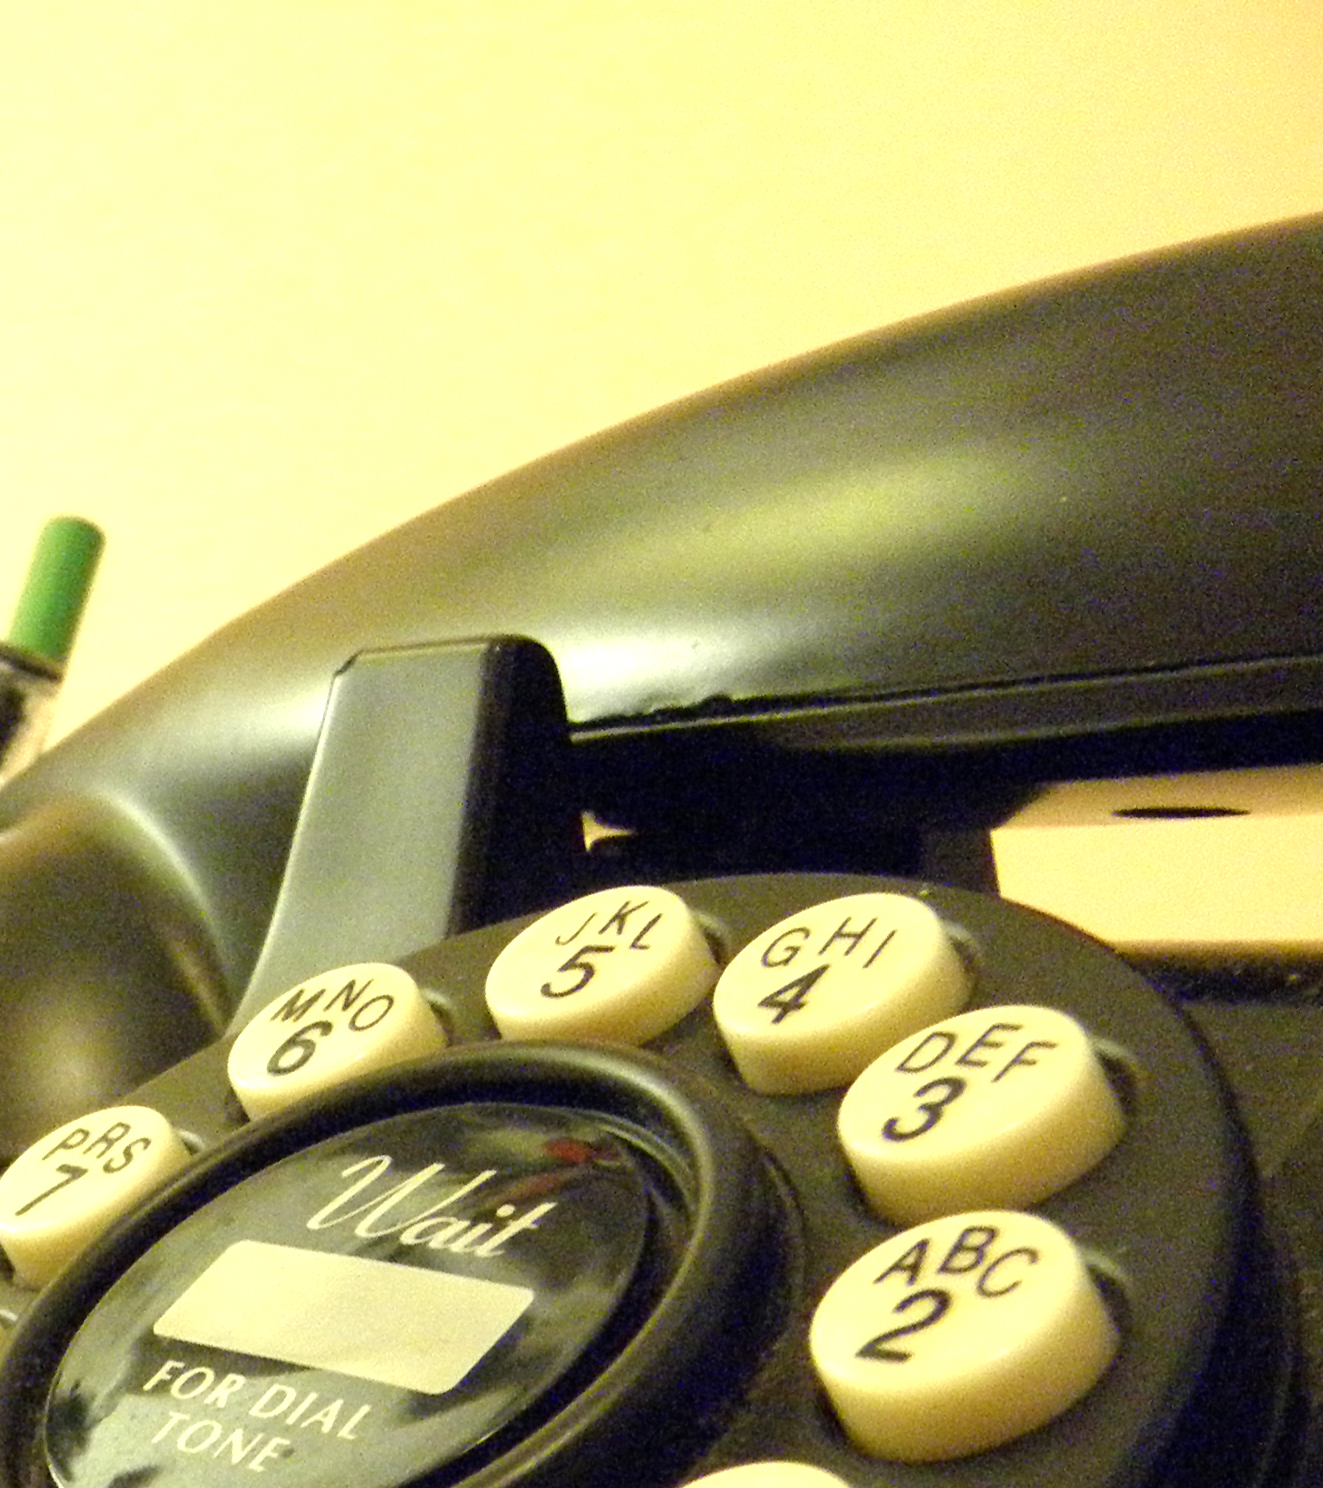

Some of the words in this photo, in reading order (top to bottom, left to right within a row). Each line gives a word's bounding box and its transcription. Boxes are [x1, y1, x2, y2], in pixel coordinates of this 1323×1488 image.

[554, 898, 664, 952] JKL
[759, 915, 898, 970] GHI
[539, 944, 616, 999] 5
[756, 963, 832, 1026] 4
[269, 978, 395, 1033] MNO
[266, 1019, 334, 1077] 6
[894, 1021, 1059, 1084] DEF
[880, 1077, 969, 1144] 3
[42, 1120, 152, 1176] PRS
[14, 1163, 88, 1219] 7
[305, 1153, 559, 1260] Wait
[872, 1224, 1042, 1299] ABC
[854, 1287, 954, 1364] 2
[141, 1359, 248, 1407] FOR
[249, 1377, 374, 1441] DIAL
[150, 1410, 292, 1474] TONE
